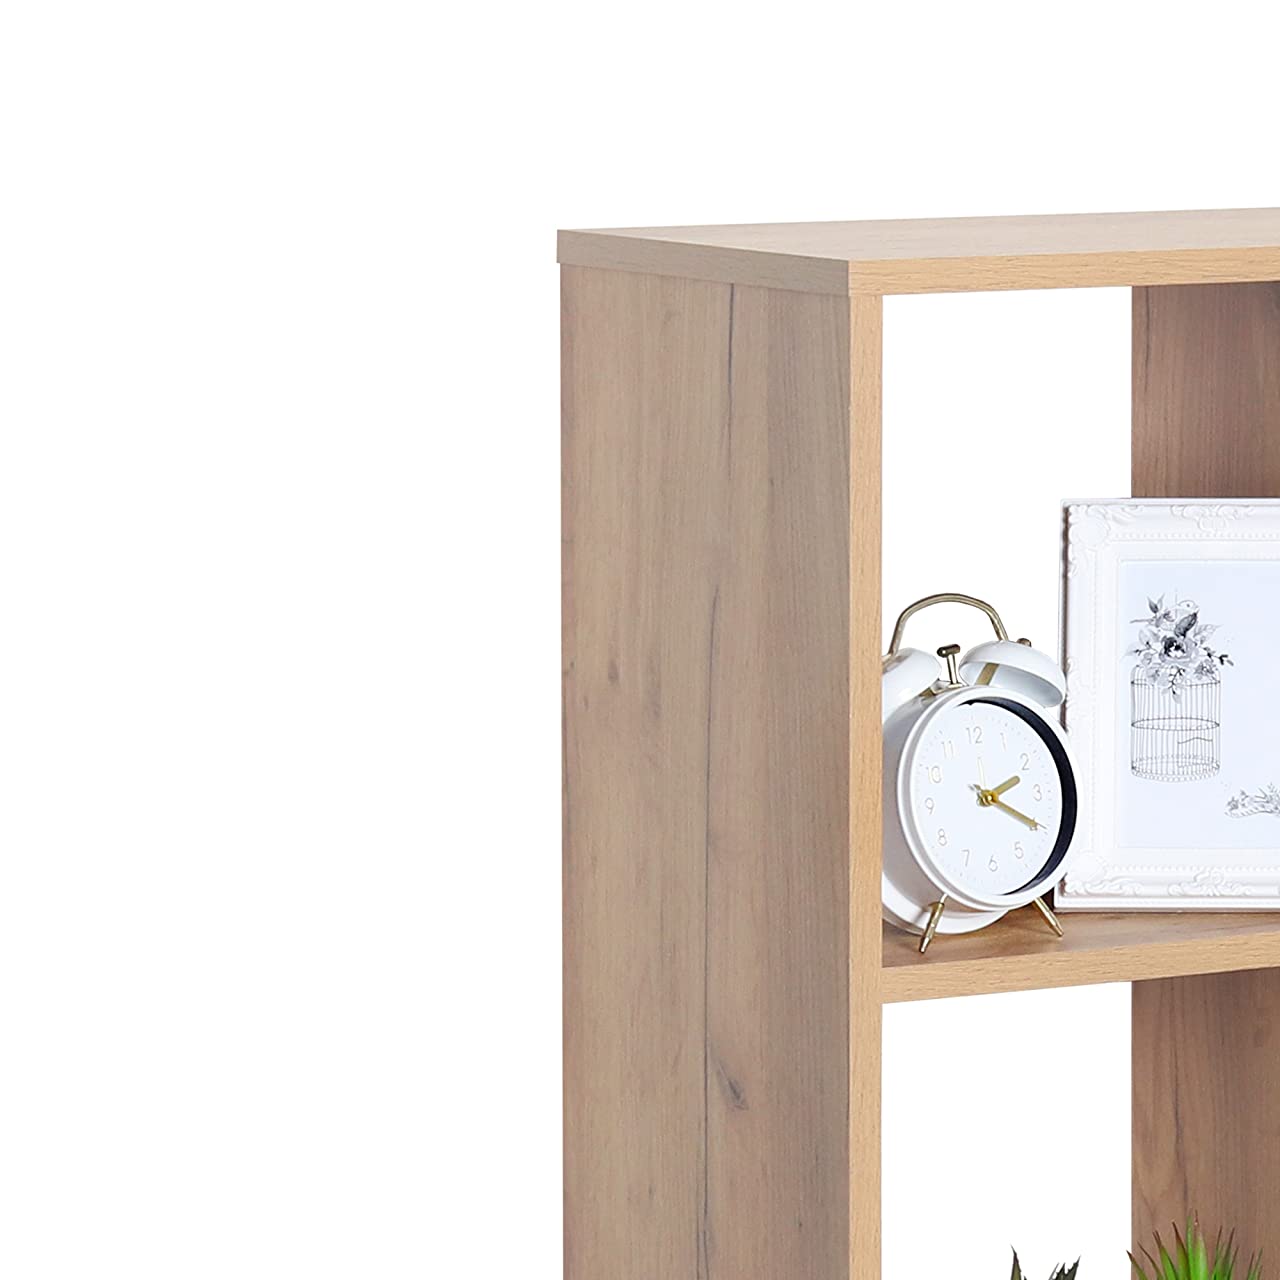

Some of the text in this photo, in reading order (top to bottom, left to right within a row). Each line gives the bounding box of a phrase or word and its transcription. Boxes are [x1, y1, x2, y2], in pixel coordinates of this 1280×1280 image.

[966, 726, 983, 744] 12
[1020, 753, 1029, 771] 2
[1033, 784, 1043, 802] 3
[925, 797, 935, 815] 9
[937, 828, 947, 846] 8
[962, 849, 970, 867] 7
[1014, 841, 1024, 859] 5
[988, 855, 998, 872] 6
